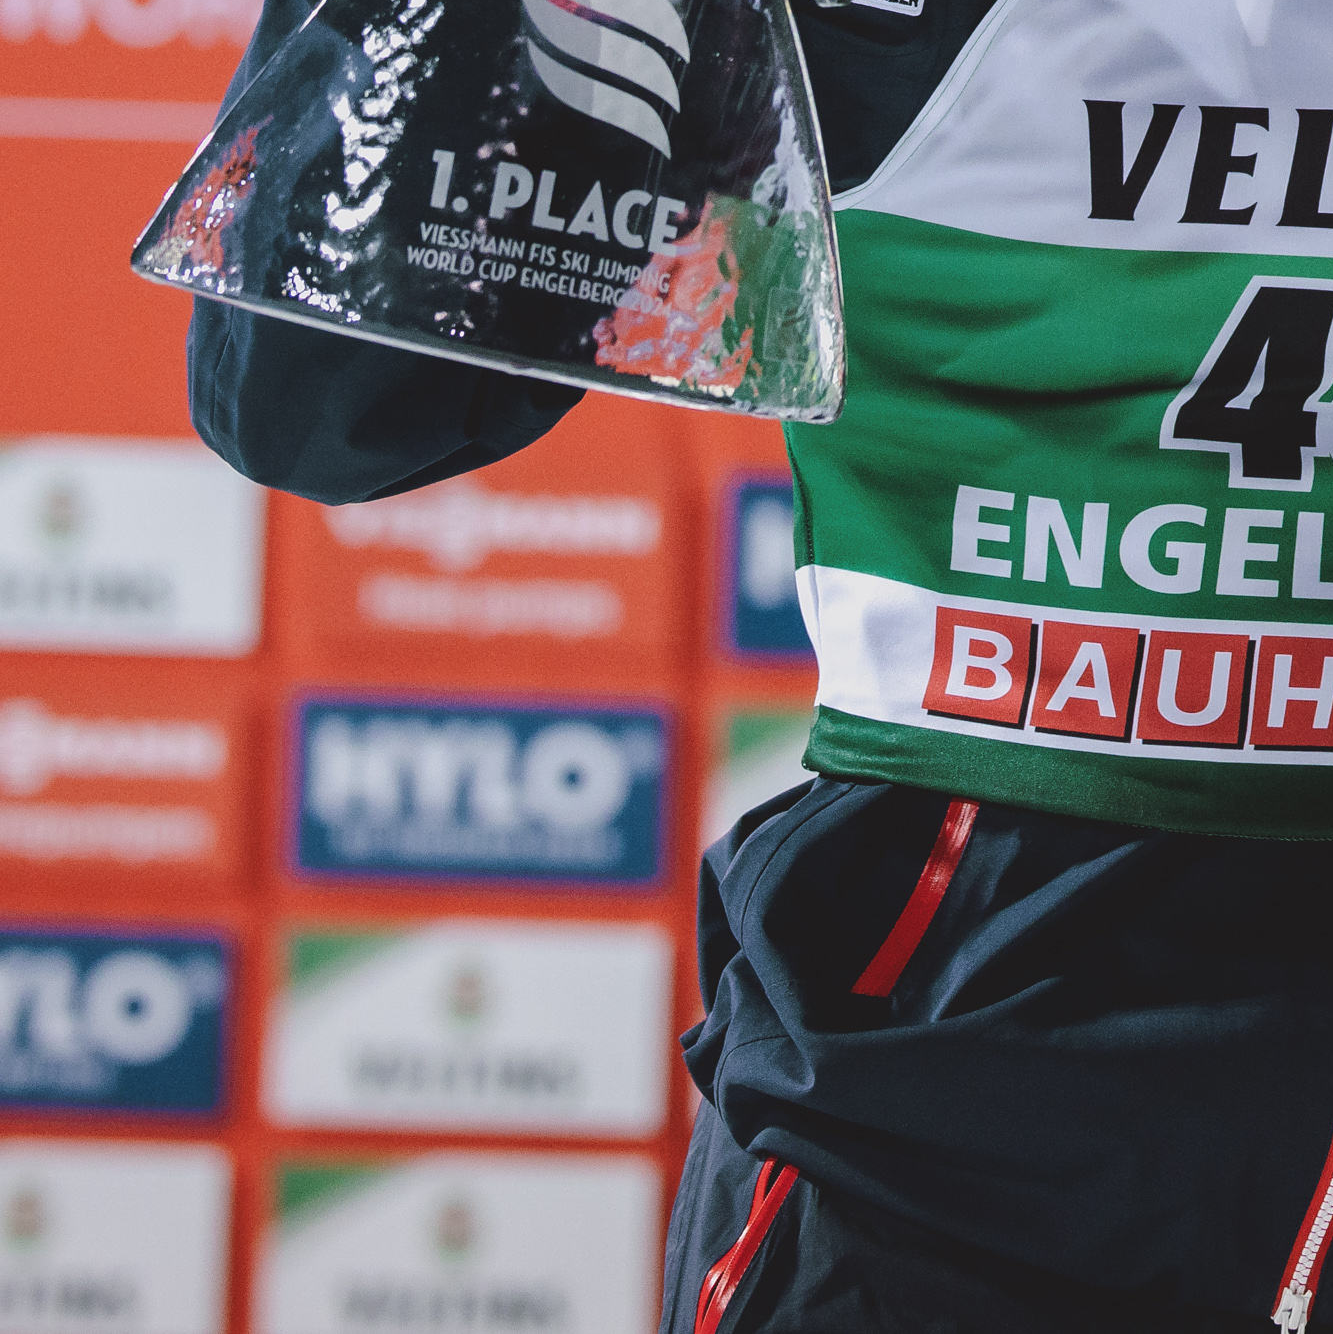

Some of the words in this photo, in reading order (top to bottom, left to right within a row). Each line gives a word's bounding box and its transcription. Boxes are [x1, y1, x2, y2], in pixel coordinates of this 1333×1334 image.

[430, 150, 469, 213] 1.
[489, 161, 687, 258] PLACE
[406, 246, 475, 278] WORLD
[478, 259, 515, 283] CUP
[520, 268, 626, 307] ENGELBERG
[420, 222, 526, 262] VIESSMANN
[528, 243, 556, 268] FIS
[560, 249, 591, 275] SKI
[592, 257, 671, 294] JUMPING
